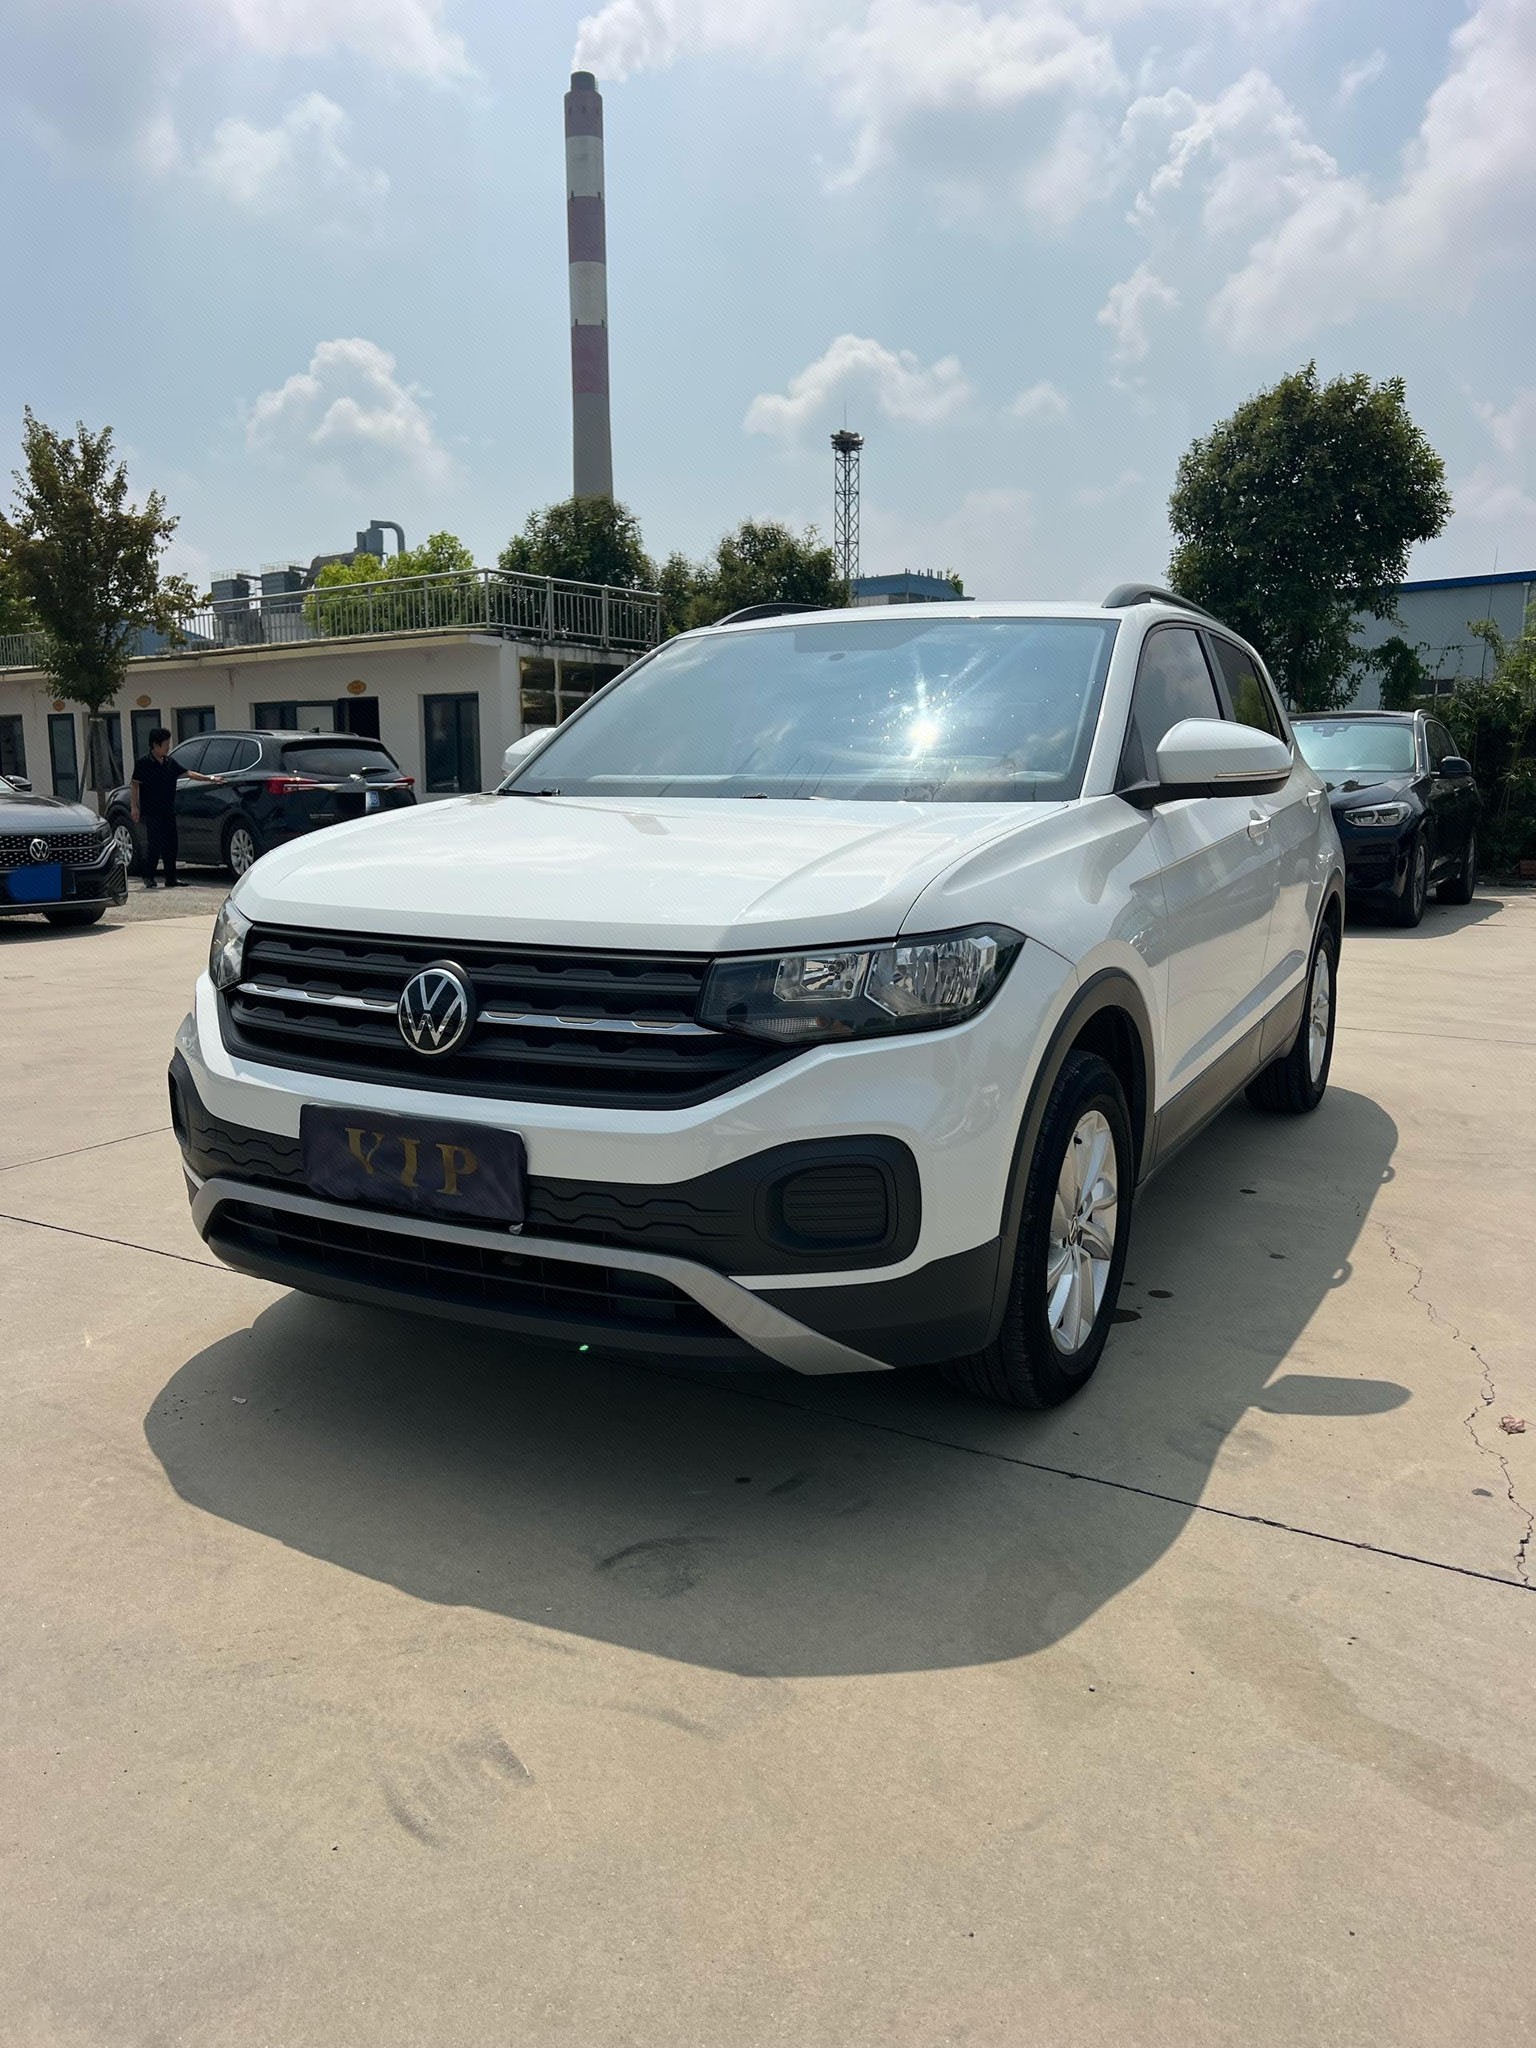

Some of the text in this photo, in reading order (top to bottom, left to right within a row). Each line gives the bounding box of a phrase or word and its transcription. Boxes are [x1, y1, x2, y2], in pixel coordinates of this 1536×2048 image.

[30, 840, 50, 860] VW
[400, 970, 467, 1052] VW
[344, 1127, 479, 1196] VIP
